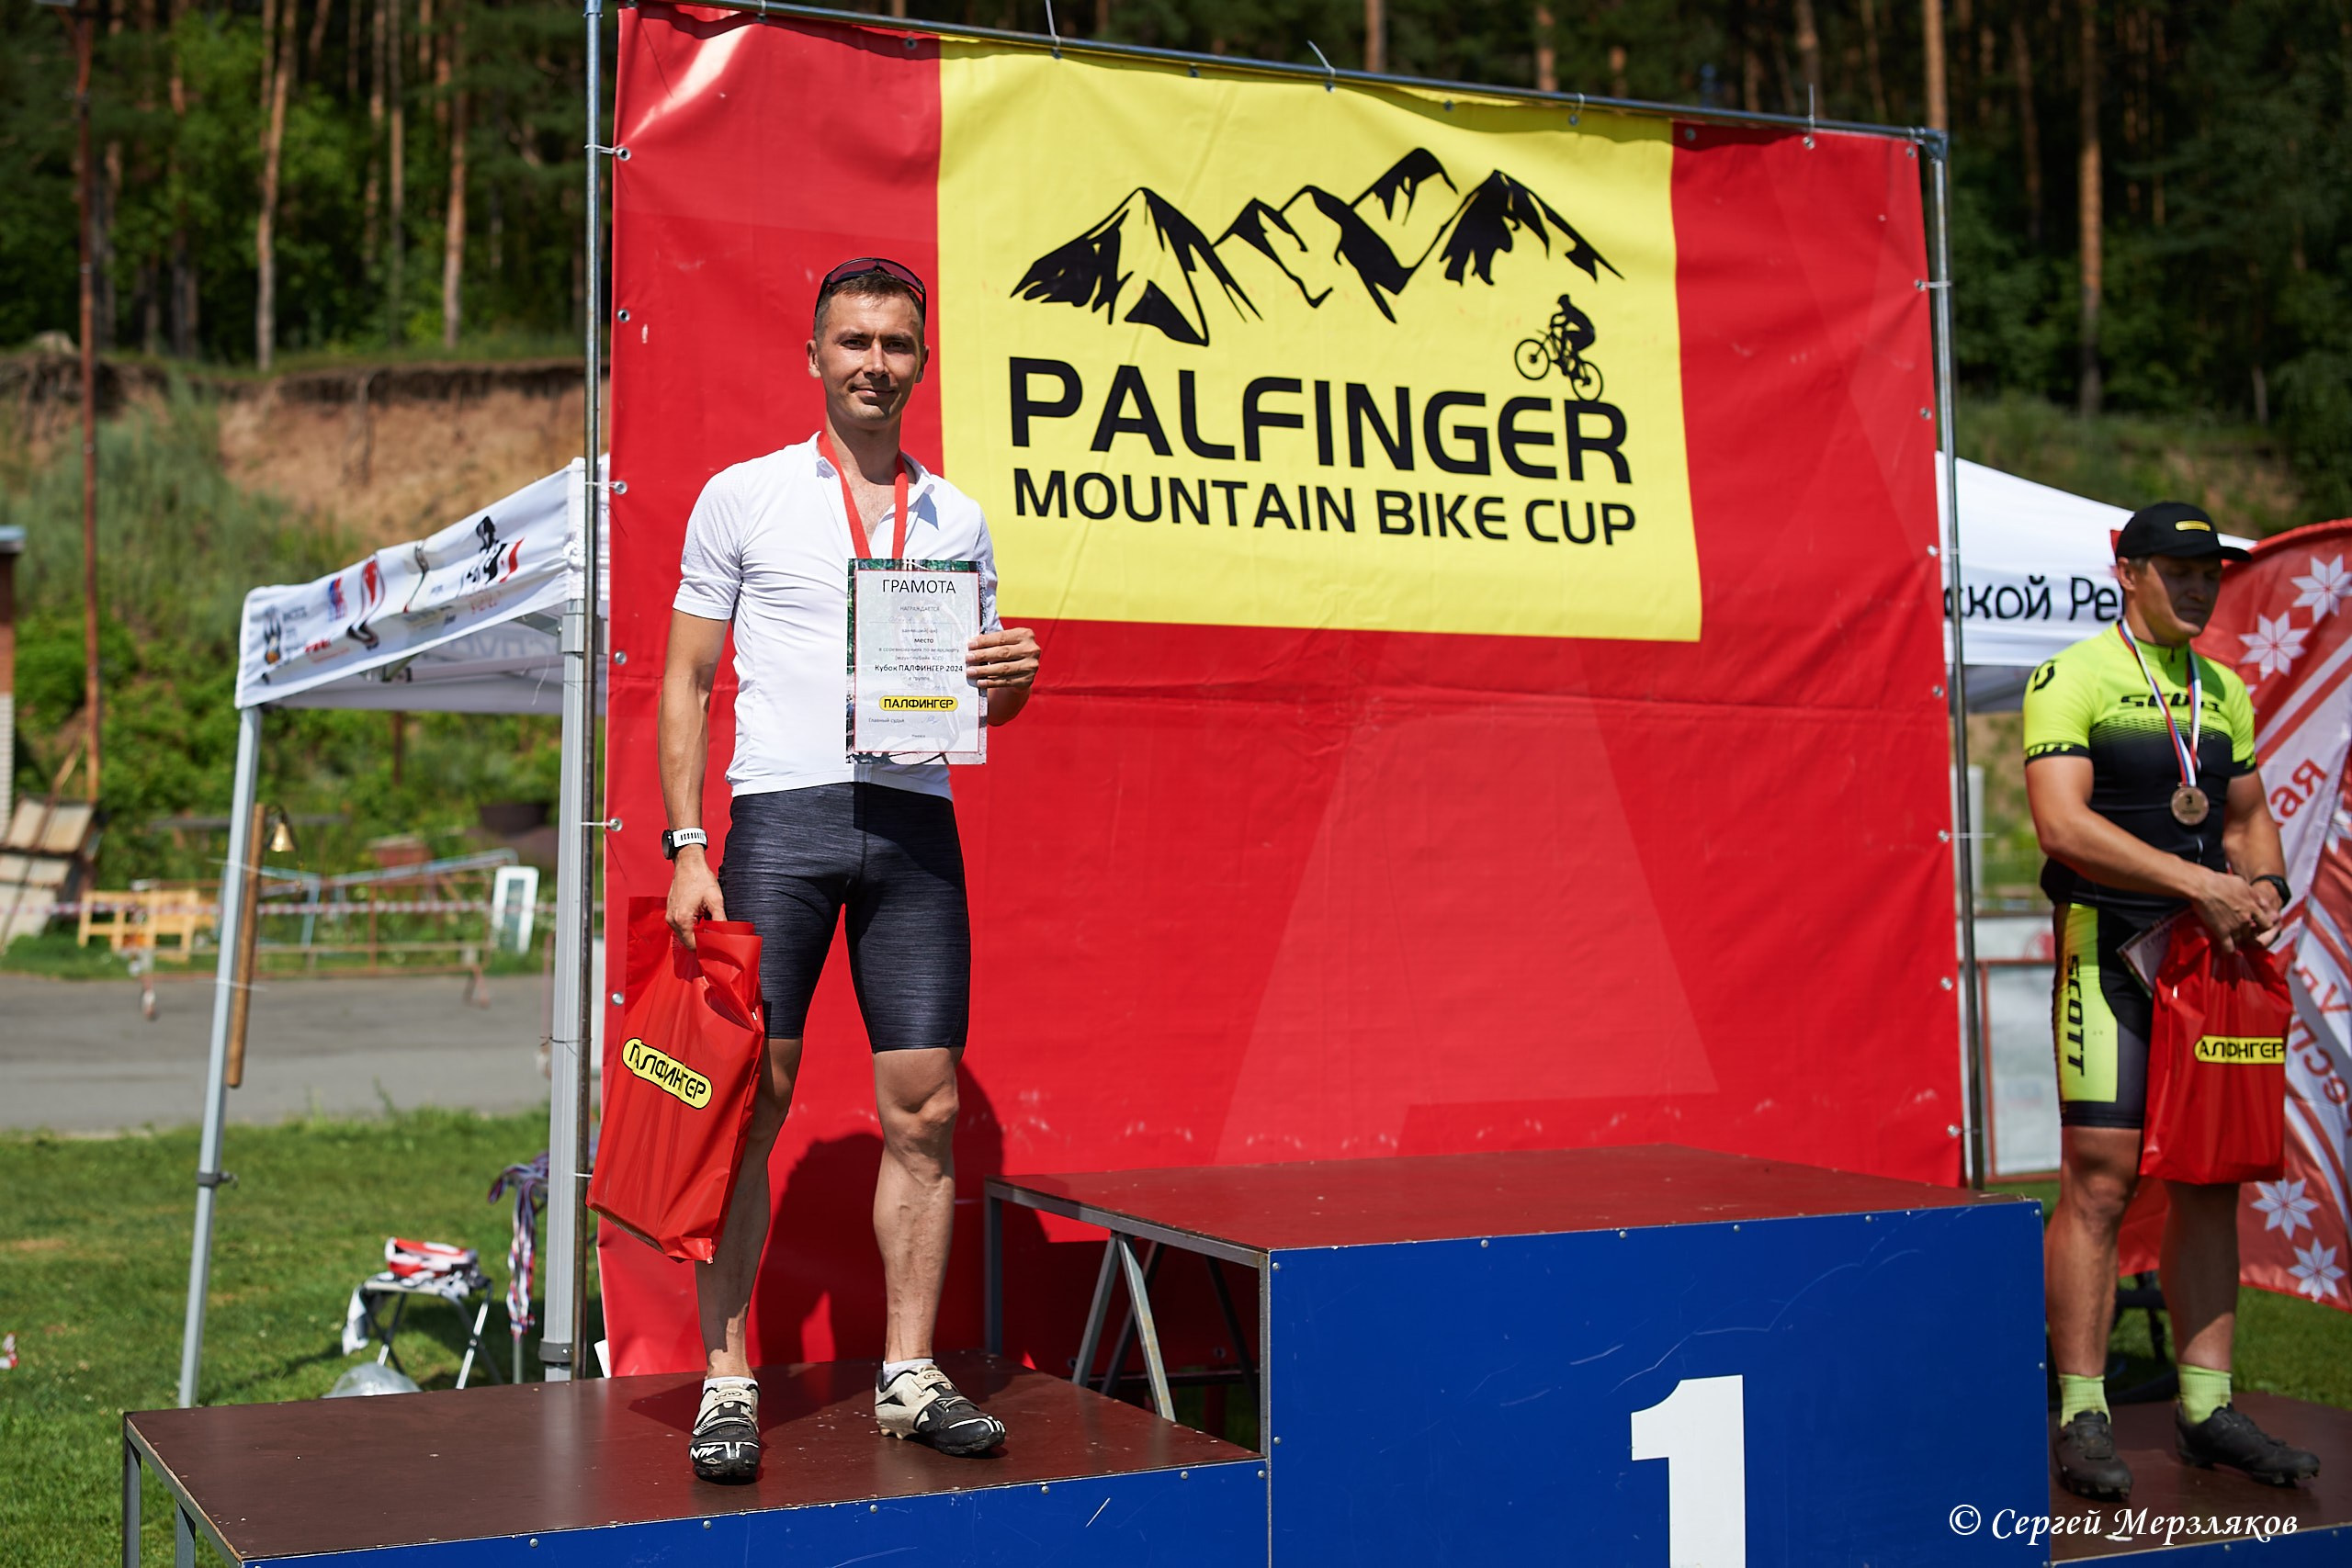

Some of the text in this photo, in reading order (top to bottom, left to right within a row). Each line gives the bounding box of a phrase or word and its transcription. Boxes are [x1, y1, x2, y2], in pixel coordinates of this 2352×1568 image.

[1009, 356, 1633, 485] PALFINGER
[1013, 468, 1636, 546] MOUNTAIN BIKE CUP
[882, 579, 956, 594] ГРАМОТА
[875, 664, 898, 672] Кубок
[884, 699, 954, 709] ПАЛФИНГЕР
[2067, 954, 2086, 1077] SCOTT
[1631, 1374, 1746, 1568] 1
